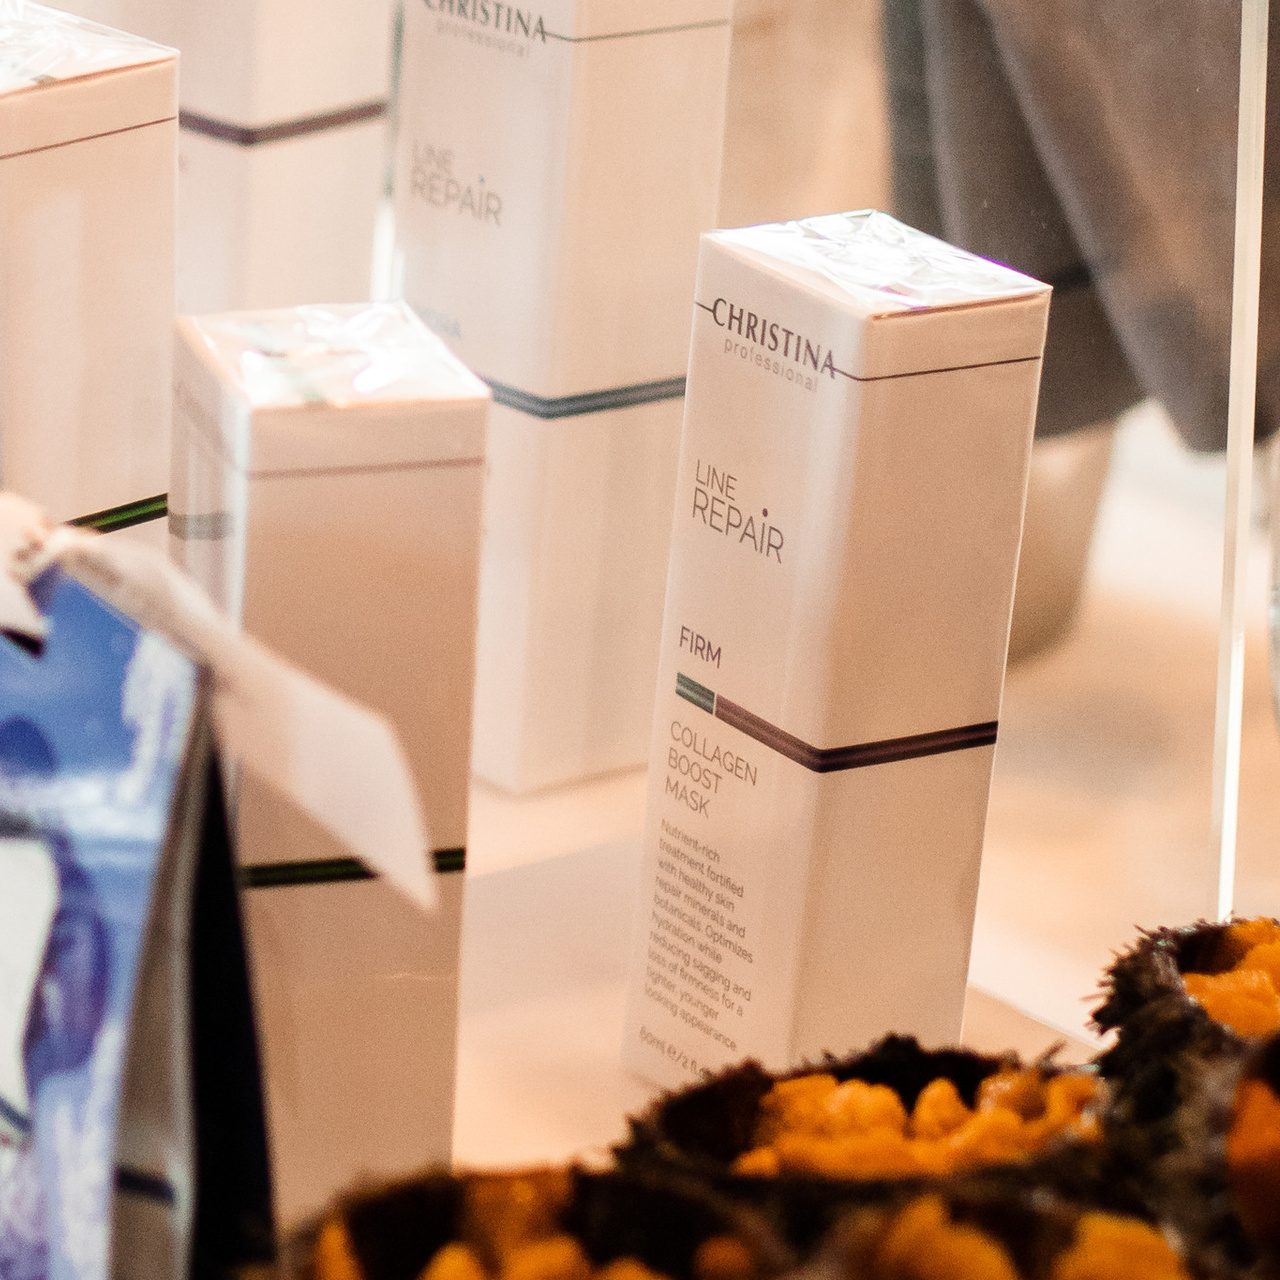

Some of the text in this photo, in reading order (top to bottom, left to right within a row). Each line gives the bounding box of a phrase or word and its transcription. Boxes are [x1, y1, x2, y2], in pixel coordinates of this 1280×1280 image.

[713, 297, 836, 380] CHRISTINA
[723, 337, 818, 393] professional
[694, 459, 738, 502] LINE
[678, 624, 722, 670] FIRM
[667, 746, 723, 794] BOOST
[670, 720, 758, 787] COLLAGEN
[664, 774, 710, 819] MASK
[706, 864, 745, 898] fortified
[715, 892, 735, 914] skin
[704, 924, 754, 965] Optimizes
[726, 919, 747, 939] and
[731, 983, 753, 1003] and
